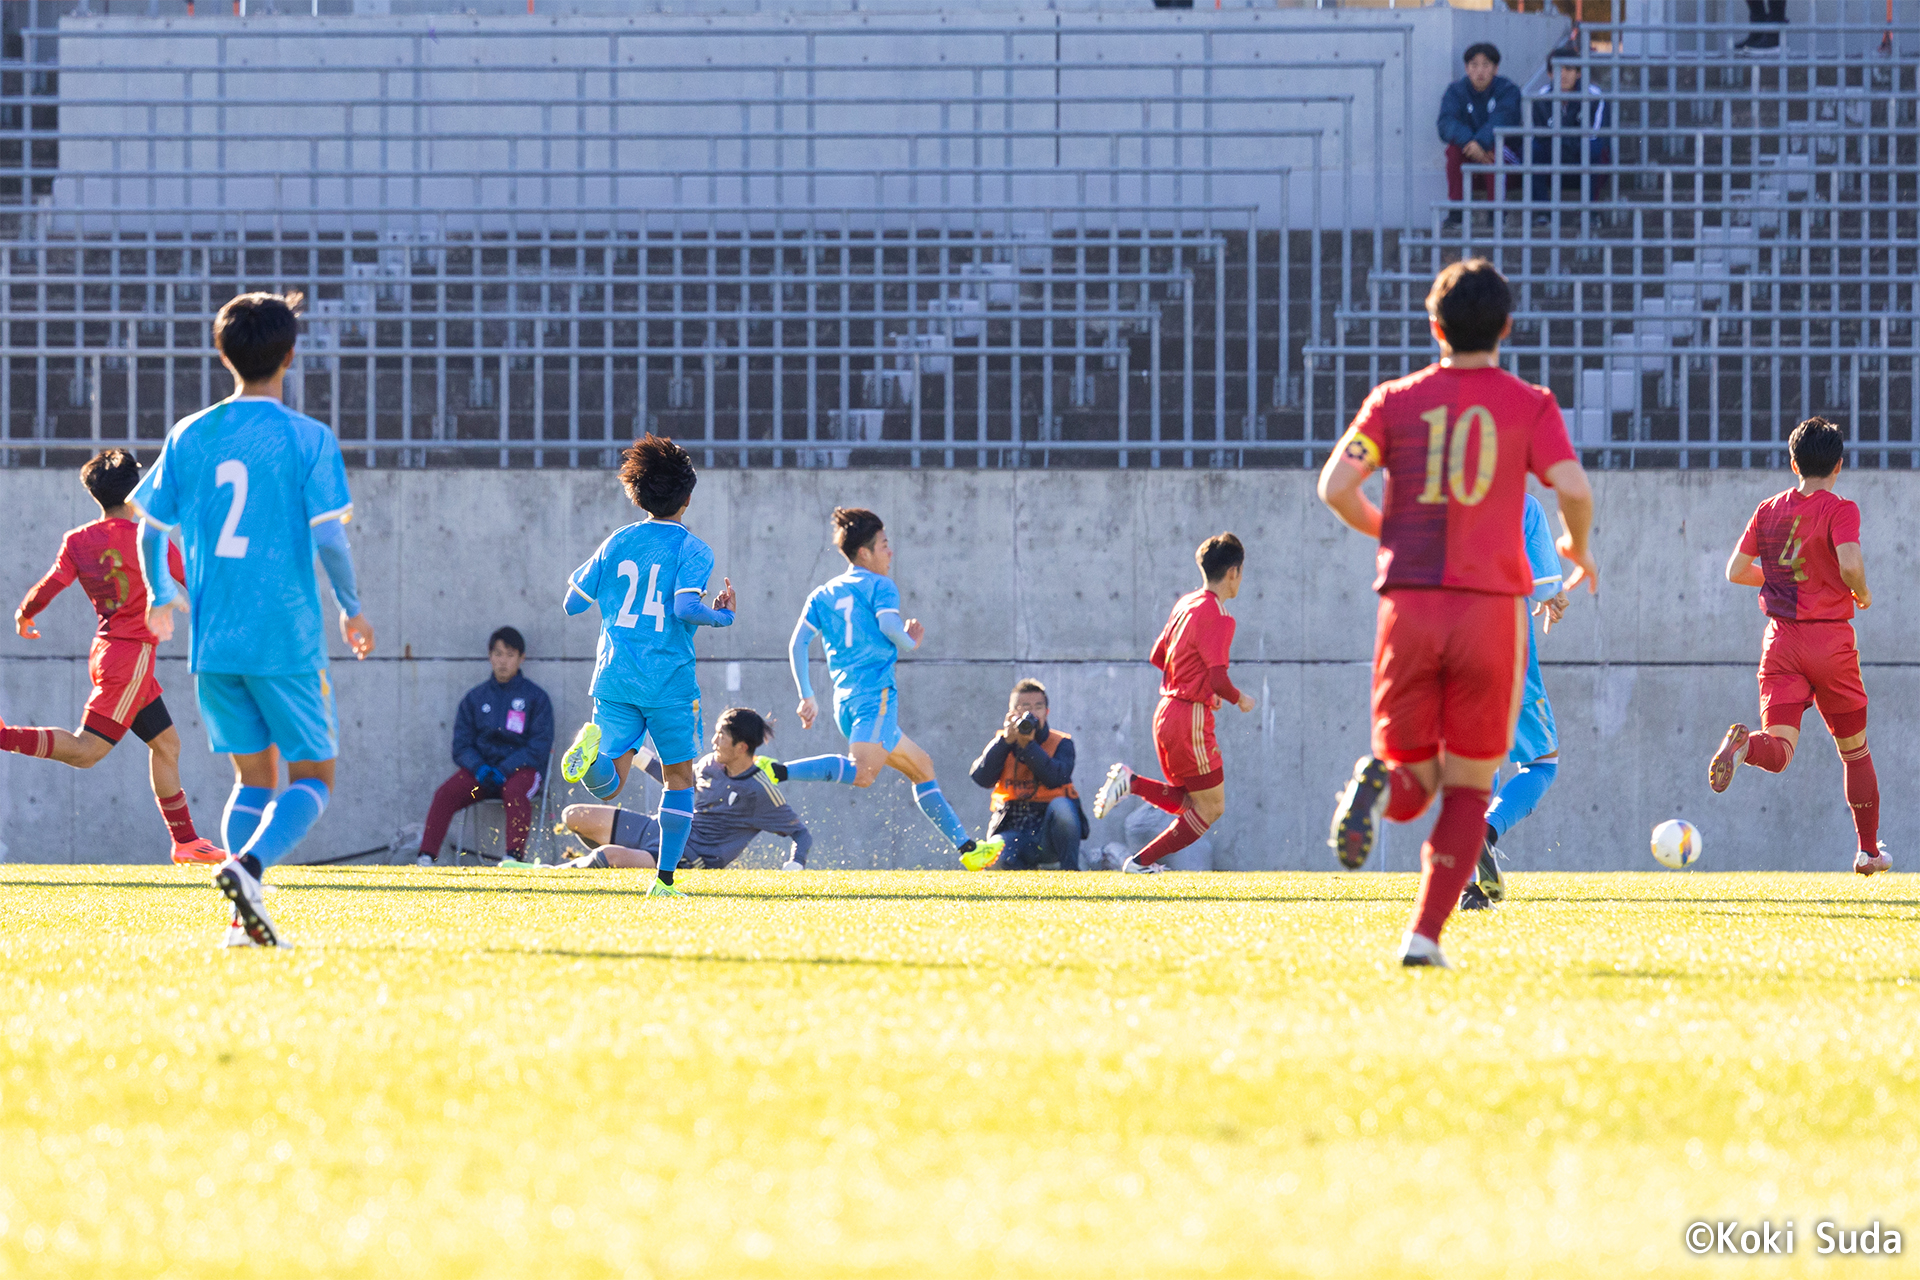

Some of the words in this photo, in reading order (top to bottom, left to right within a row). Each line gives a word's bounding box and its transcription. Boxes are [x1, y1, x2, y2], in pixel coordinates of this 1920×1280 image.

[1416, 404, 1498, 507] 10
[215, 459, 250, 559] 2
[99, 547, 130, 611] 3
[1778, 514, 1809, 582] 4
[614, 559, 666, 632] 24
[834, 593, 855, 648] 7
